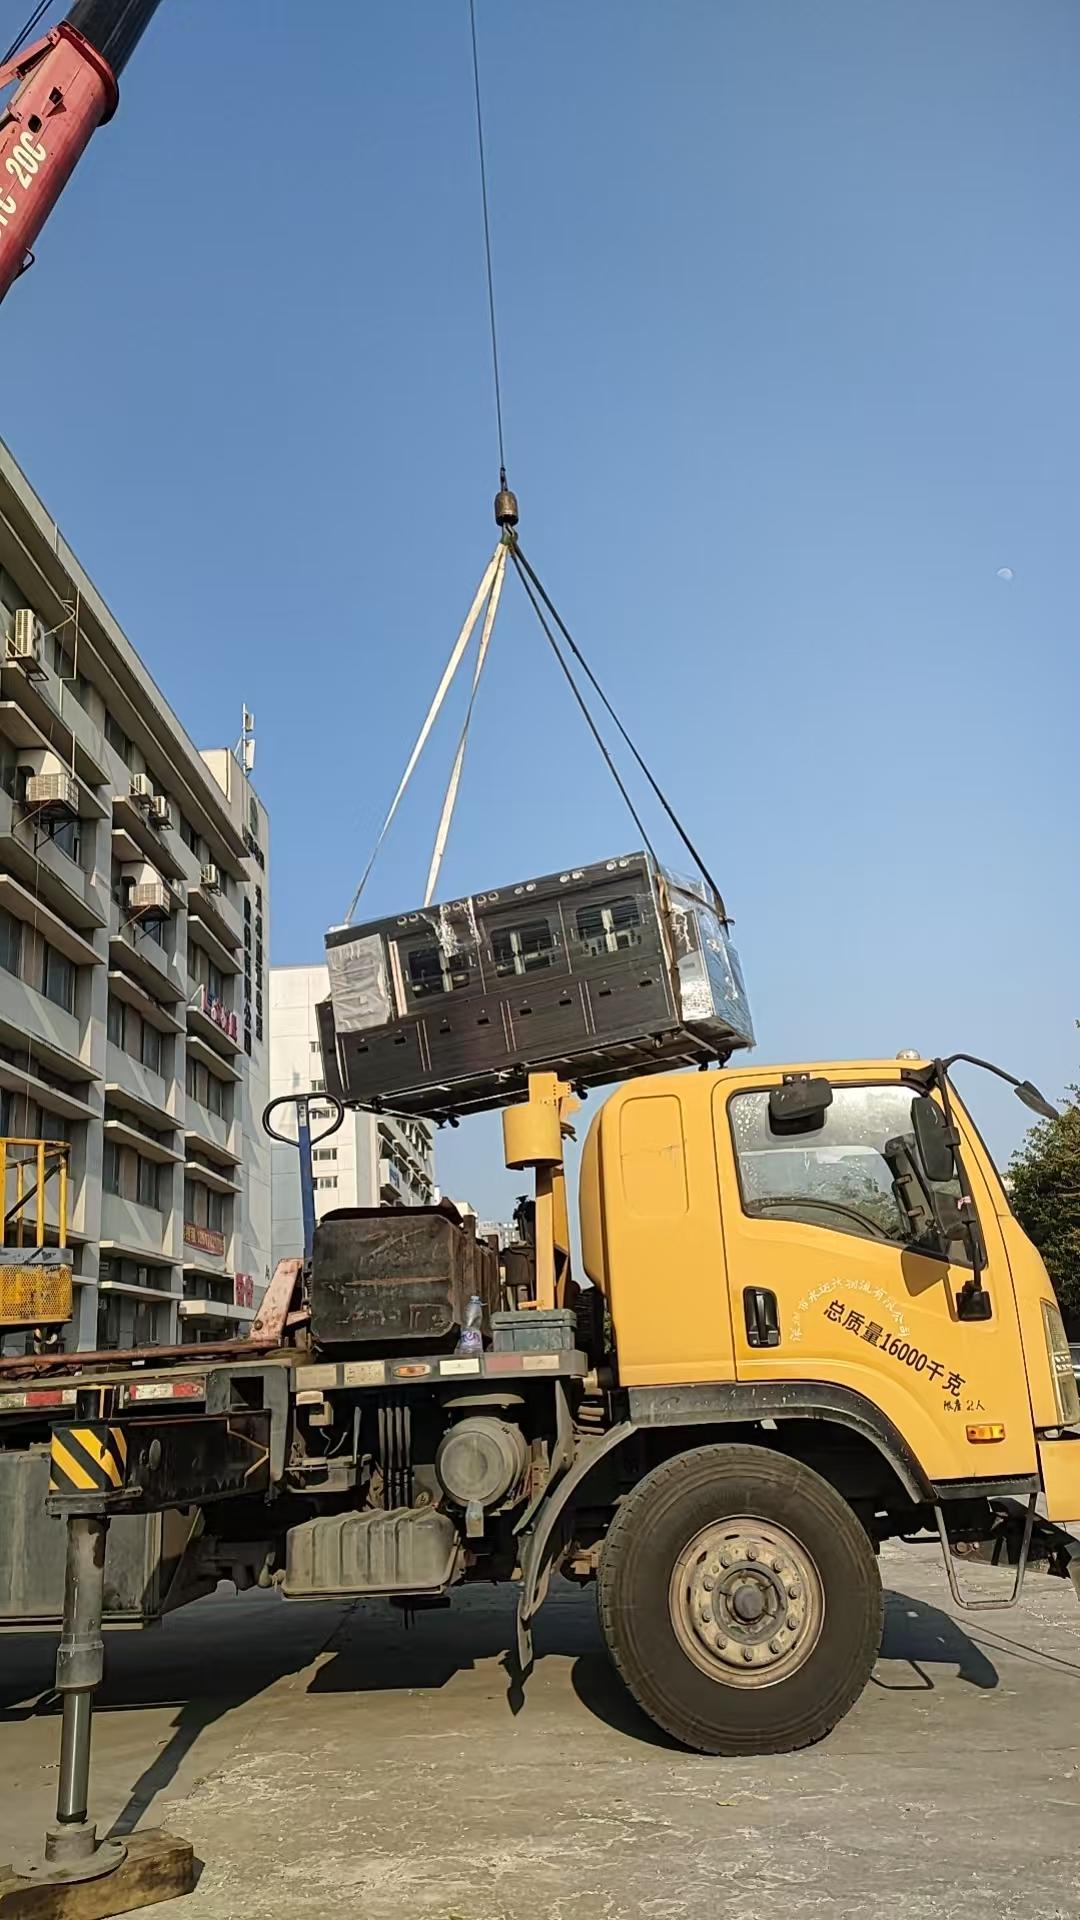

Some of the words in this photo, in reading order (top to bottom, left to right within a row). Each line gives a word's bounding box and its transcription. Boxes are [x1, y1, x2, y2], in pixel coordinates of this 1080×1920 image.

[5, 131, 46, 190] 20C
[823, 1300, 966, 1397] 总质量16000千克
